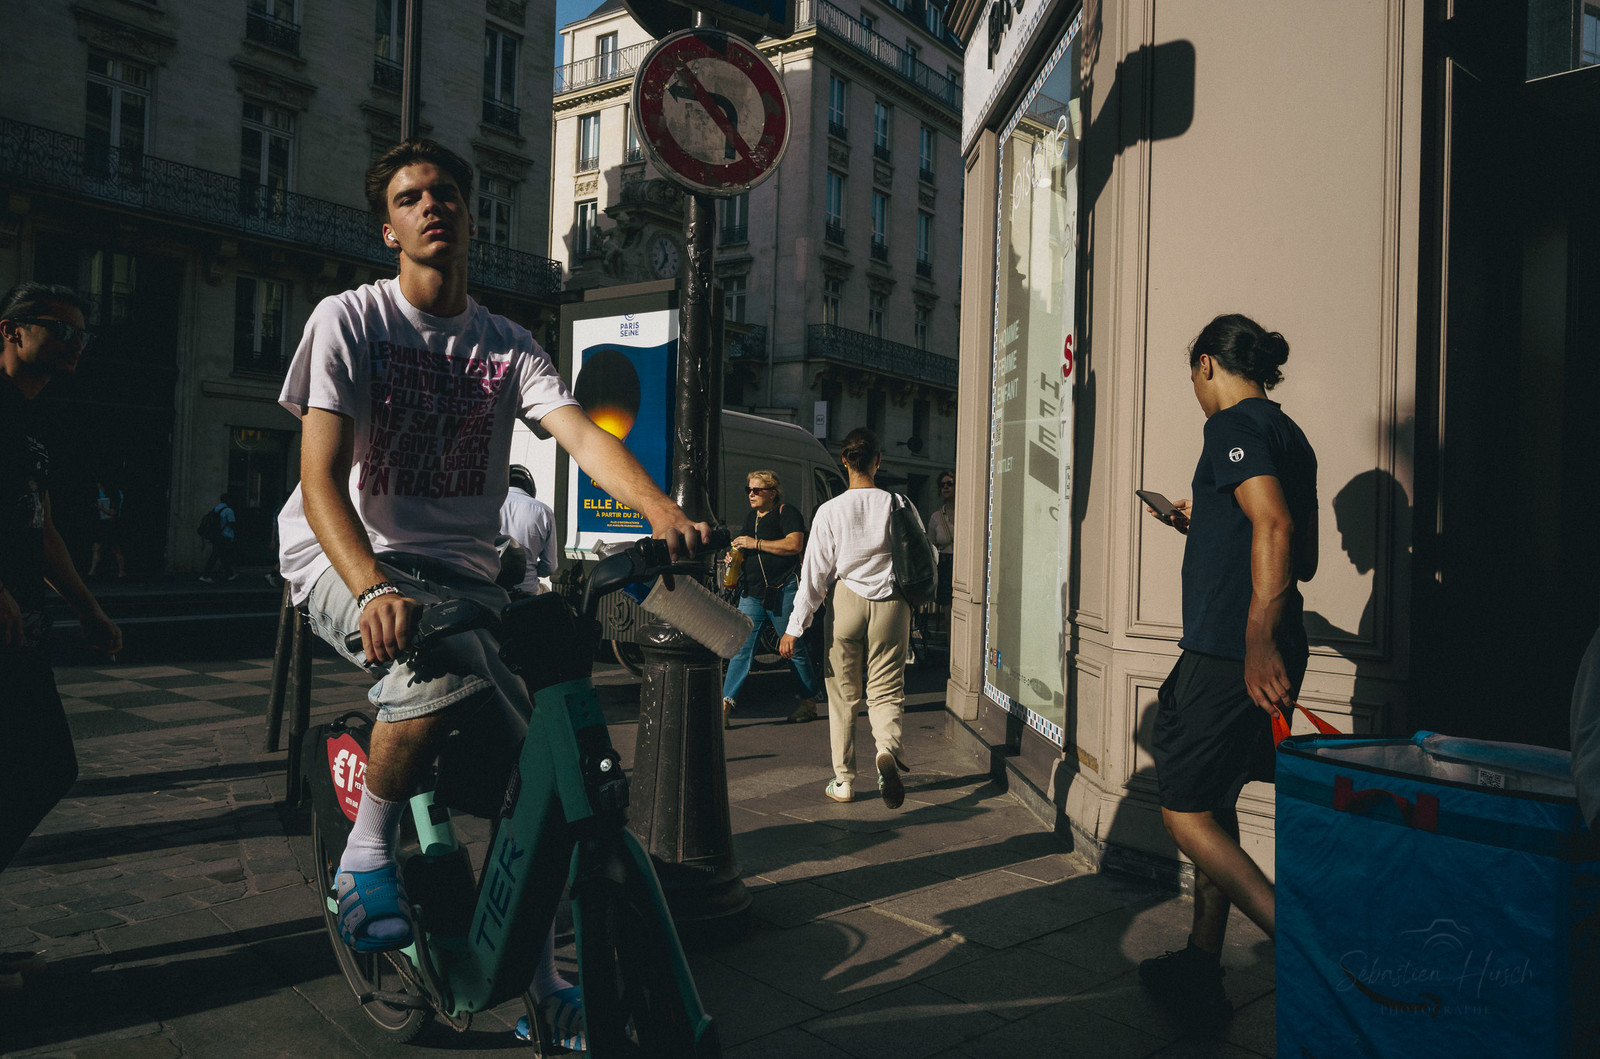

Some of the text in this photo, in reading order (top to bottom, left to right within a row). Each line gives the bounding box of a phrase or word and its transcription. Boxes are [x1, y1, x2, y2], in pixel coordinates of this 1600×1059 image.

[620, 322, 640, 330] PARIS
[997, 378, 1019, 406] ENFANT
[399, 432, 439, 455] GIVE
[389, 450, 420, 469] SUR
[423, 454, 442, 470] LA
[444, 453, 489, 472] GUEULE
[584, 499, 612, 510] ELLE
[476, 837, 524, 952] TIER
